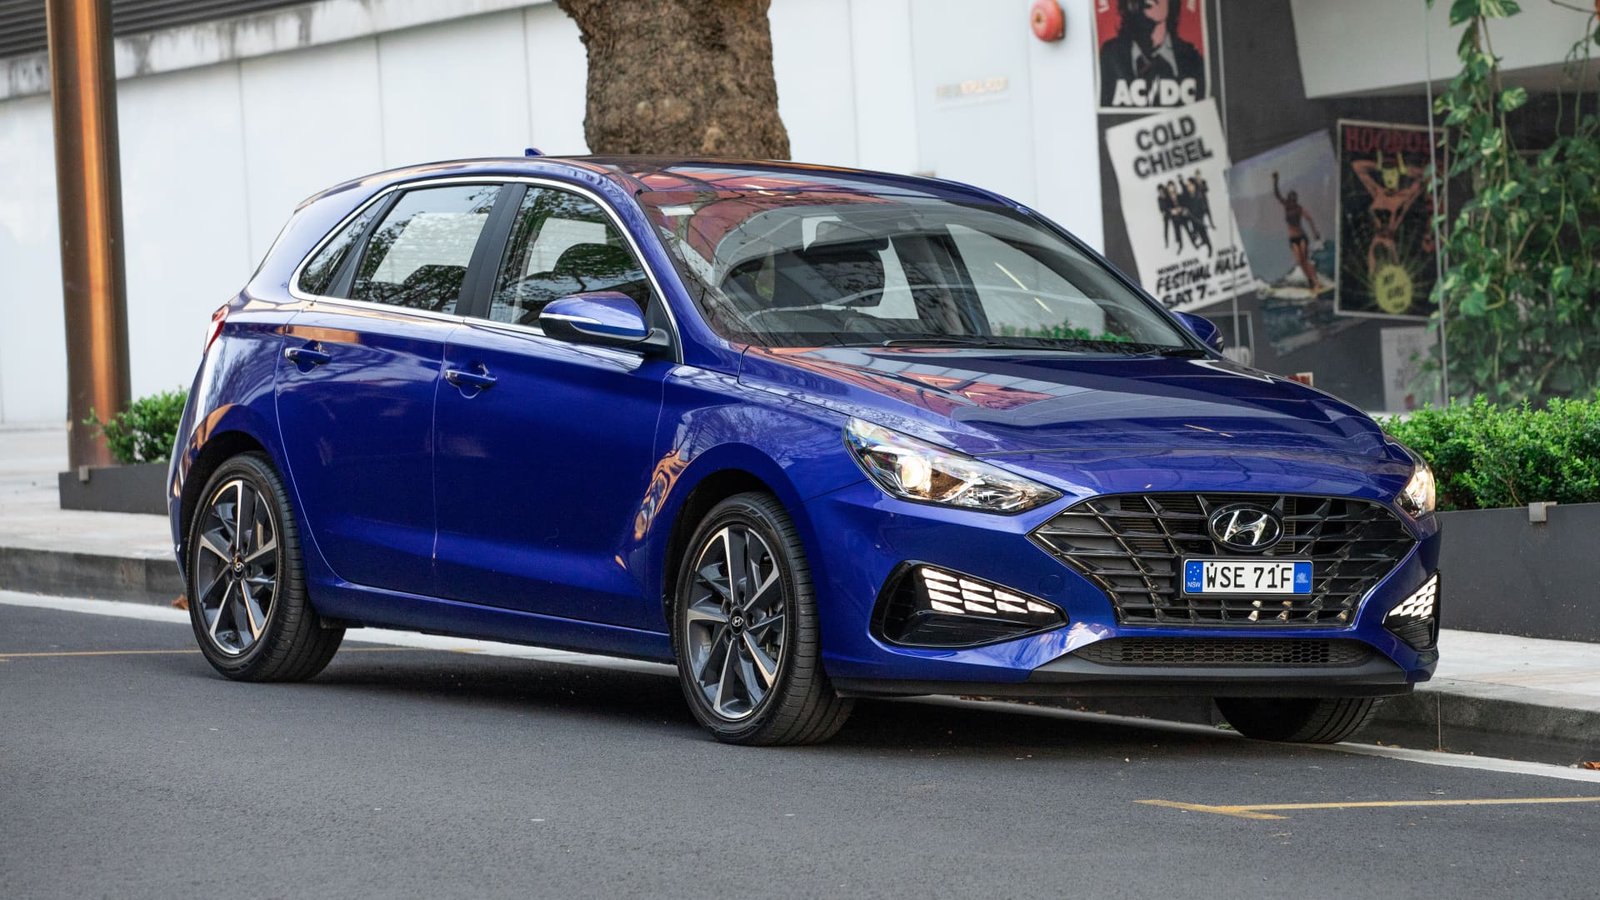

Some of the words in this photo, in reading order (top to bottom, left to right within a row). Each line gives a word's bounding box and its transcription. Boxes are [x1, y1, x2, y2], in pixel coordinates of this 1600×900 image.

[1112, 77, 1197, 107] AC/DC
[1135, 115, 1196, 151] COLD
[1133, 137, 1213, 180] CHISEL
[1156, 264, 1211, 295] FESTIVAL
[1214, 252, 1247, 275] HALL
[1162, 289, 1193, 309] SAT
[1196, 284, 1207, 300] 7
[1206, 566, 1245, 588] WSE
[1253, 566, 1292, 589] 71F
